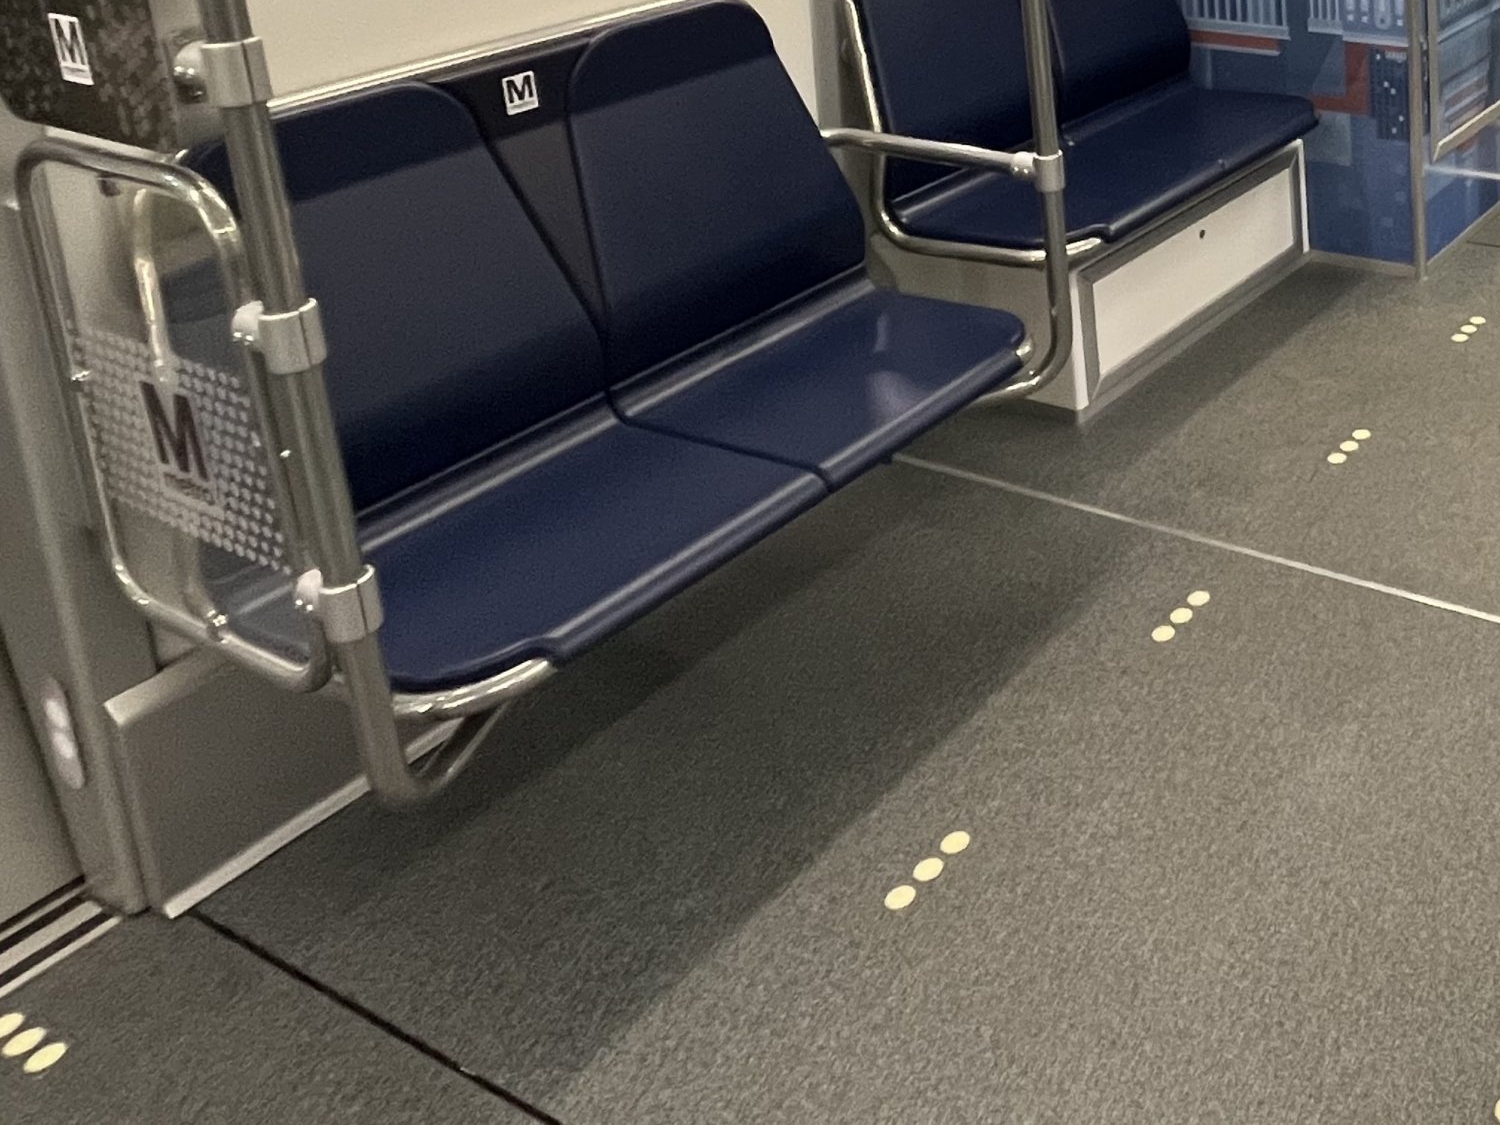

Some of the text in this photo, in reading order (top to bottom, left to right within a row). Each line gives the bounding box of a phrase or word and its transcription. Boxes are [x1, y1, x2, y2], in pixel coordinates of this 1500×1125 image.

[53, 18, 87, 65] M
[505, 74, 534, 104] M
[139, 380, 210, 483] M
